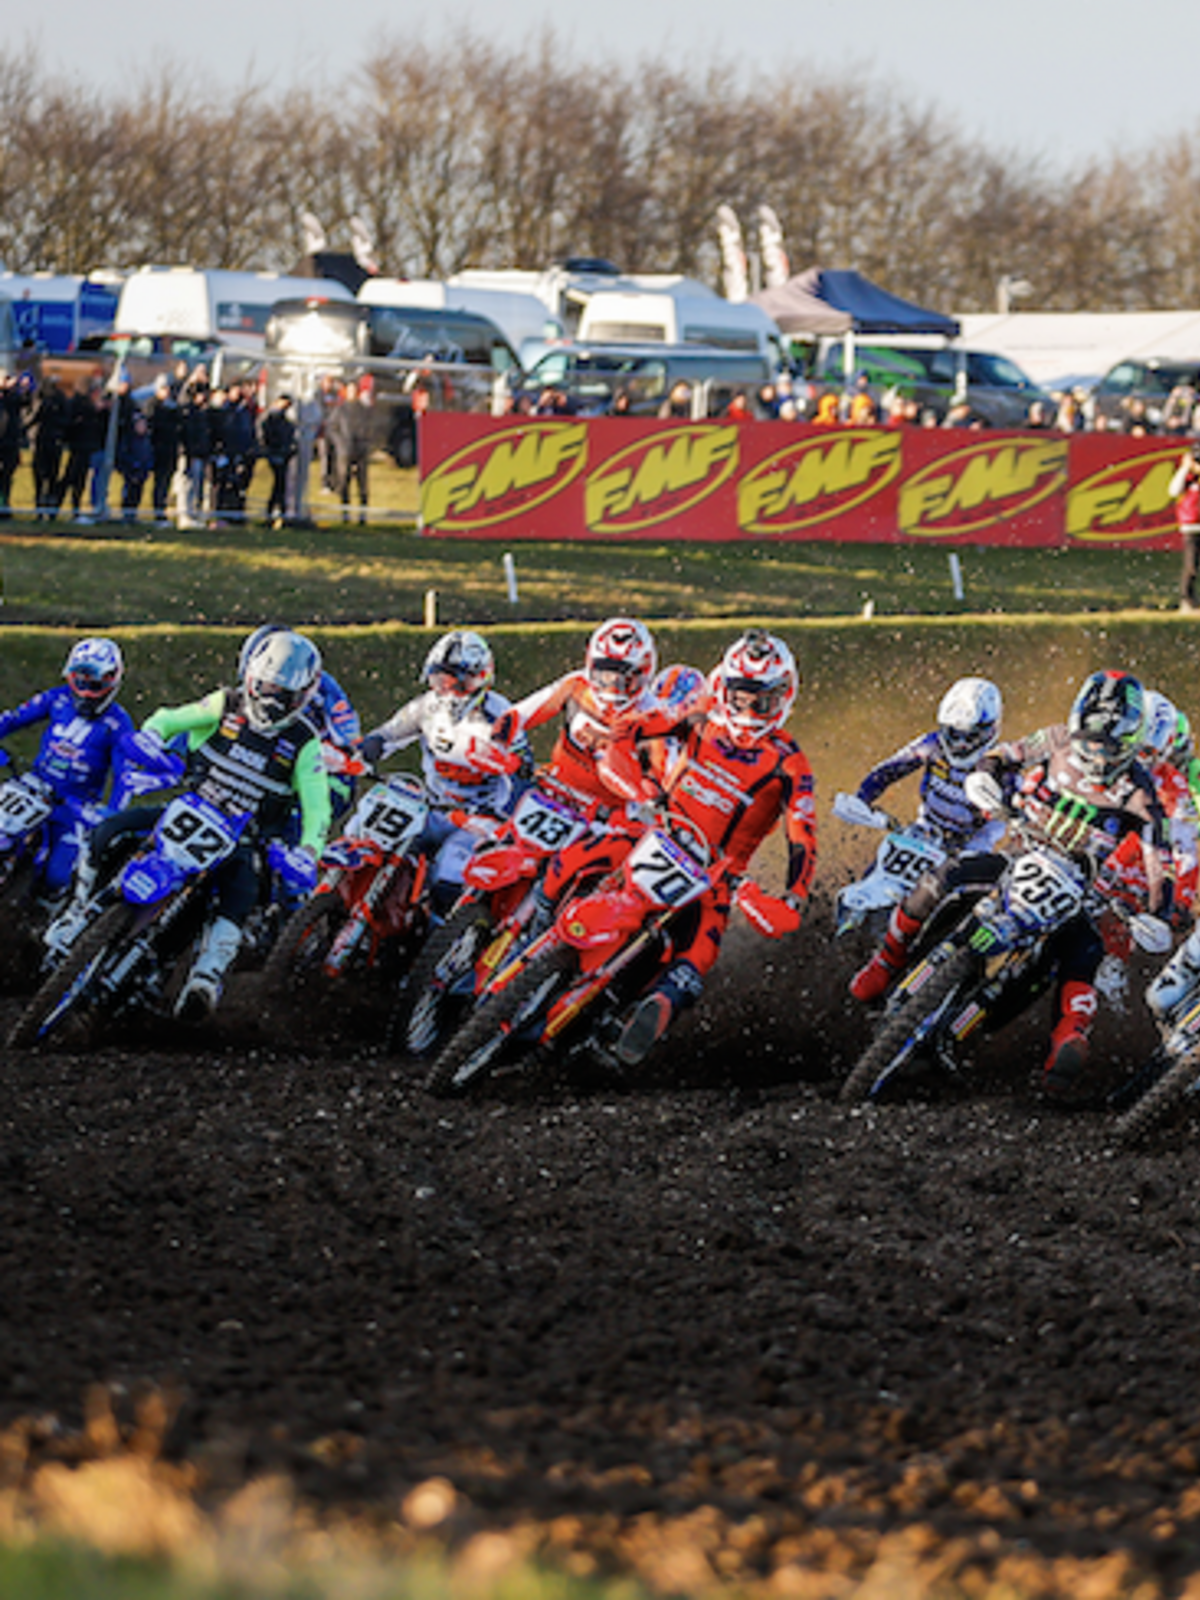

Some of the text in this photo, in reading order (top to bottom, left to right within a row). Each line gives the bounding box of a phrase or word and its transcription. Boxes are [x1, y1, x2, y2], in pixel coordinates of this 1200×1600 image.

[419, 423, 588, 527] FMF
[585, 425, 738, 530] FMF
[737, 431, 901, 531] FMF
[899, 440, 1069, 533] FMF
[161, 811, 226, 864] 92
[518, 810, 573, 845] 43
[634, 851, 695, 903] 70
[1015, 863, 1074, 916] 259
